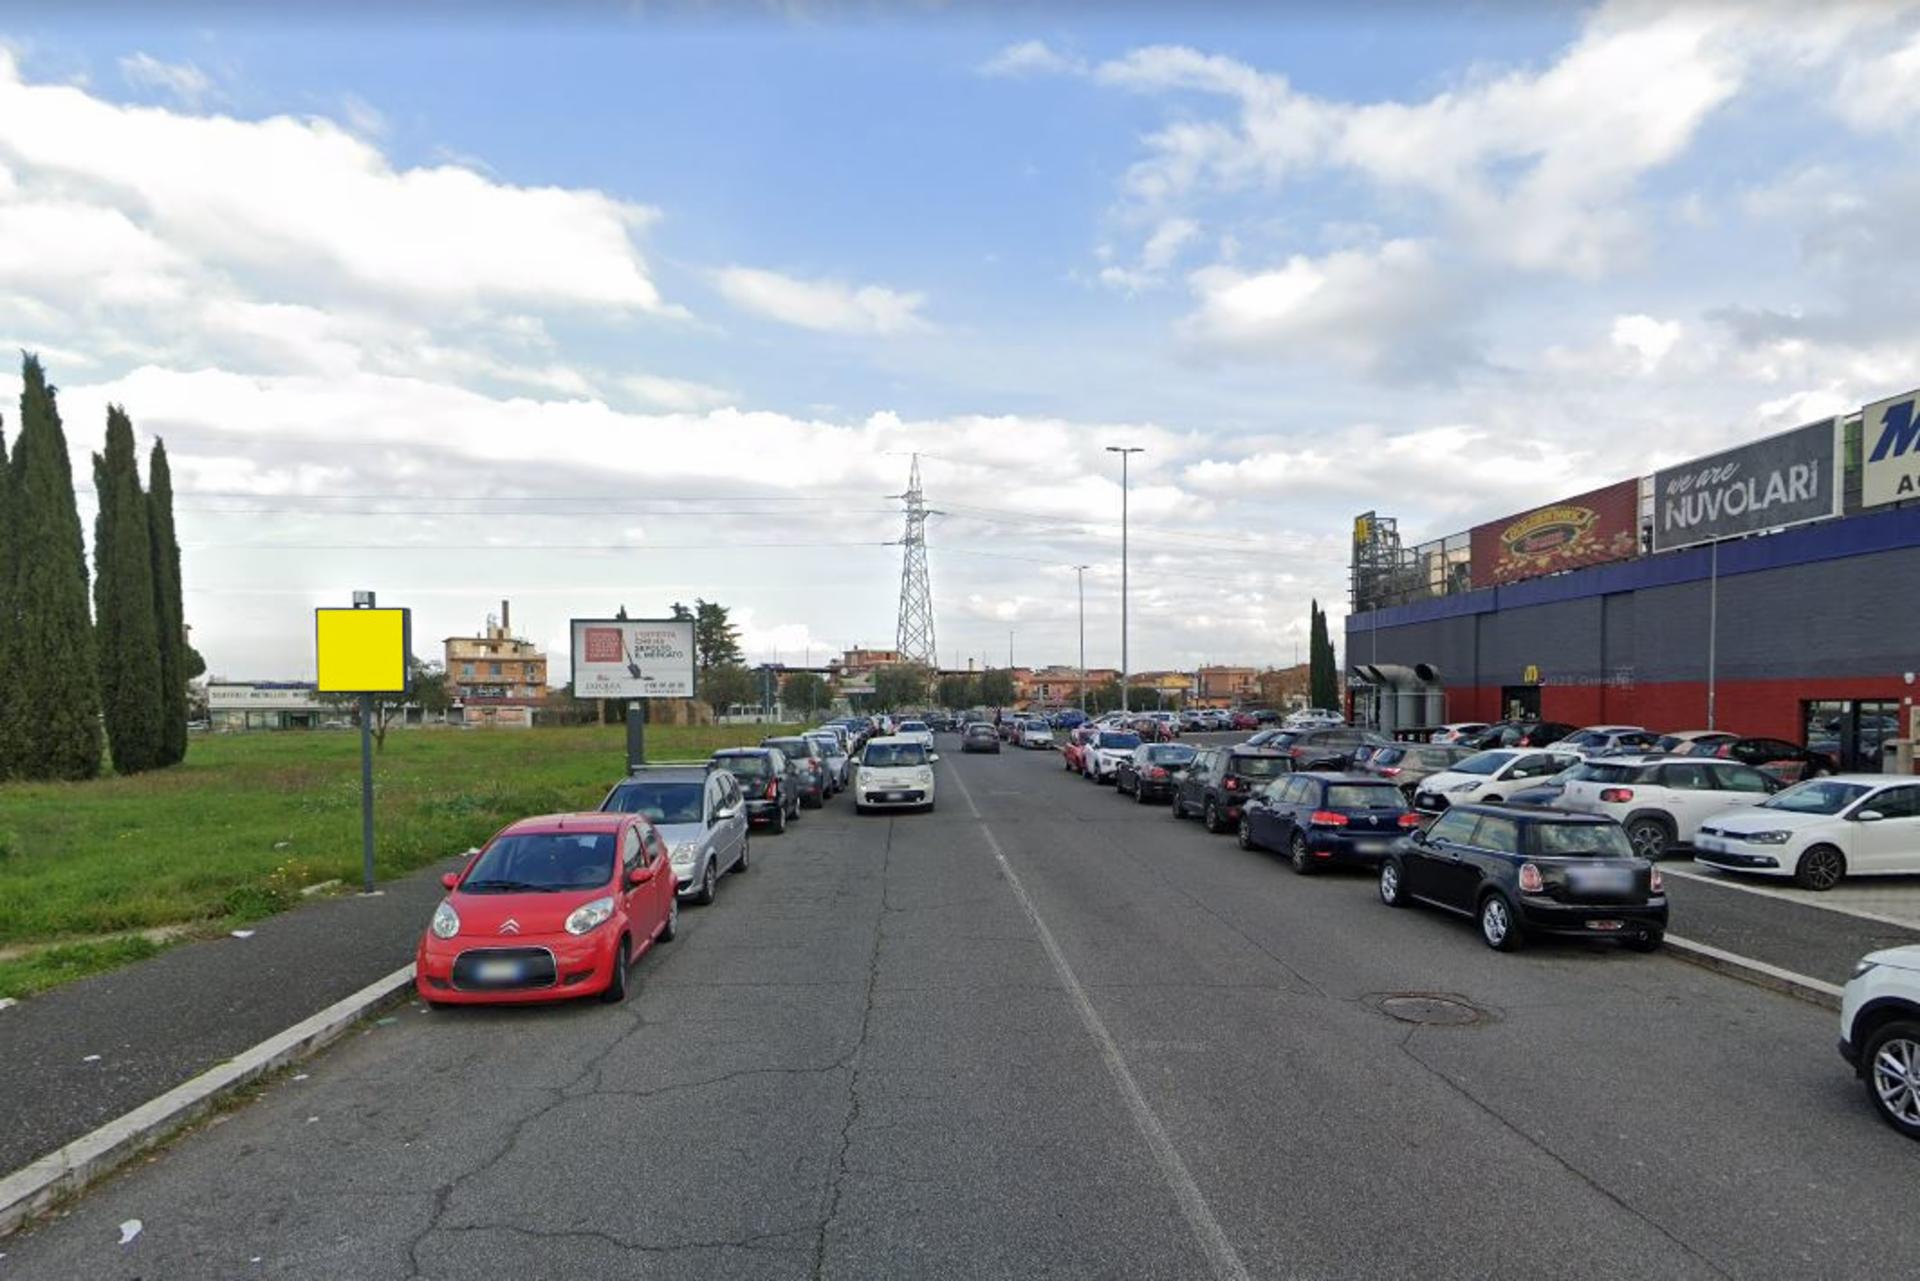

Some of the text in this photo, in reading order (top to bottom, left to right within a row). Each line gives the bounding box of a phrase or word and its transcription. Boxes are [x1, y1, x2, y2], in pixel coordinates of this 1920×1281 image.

[1666, 462, 1740, 496] we are
[644, 650, 684, 659] MERCATO
